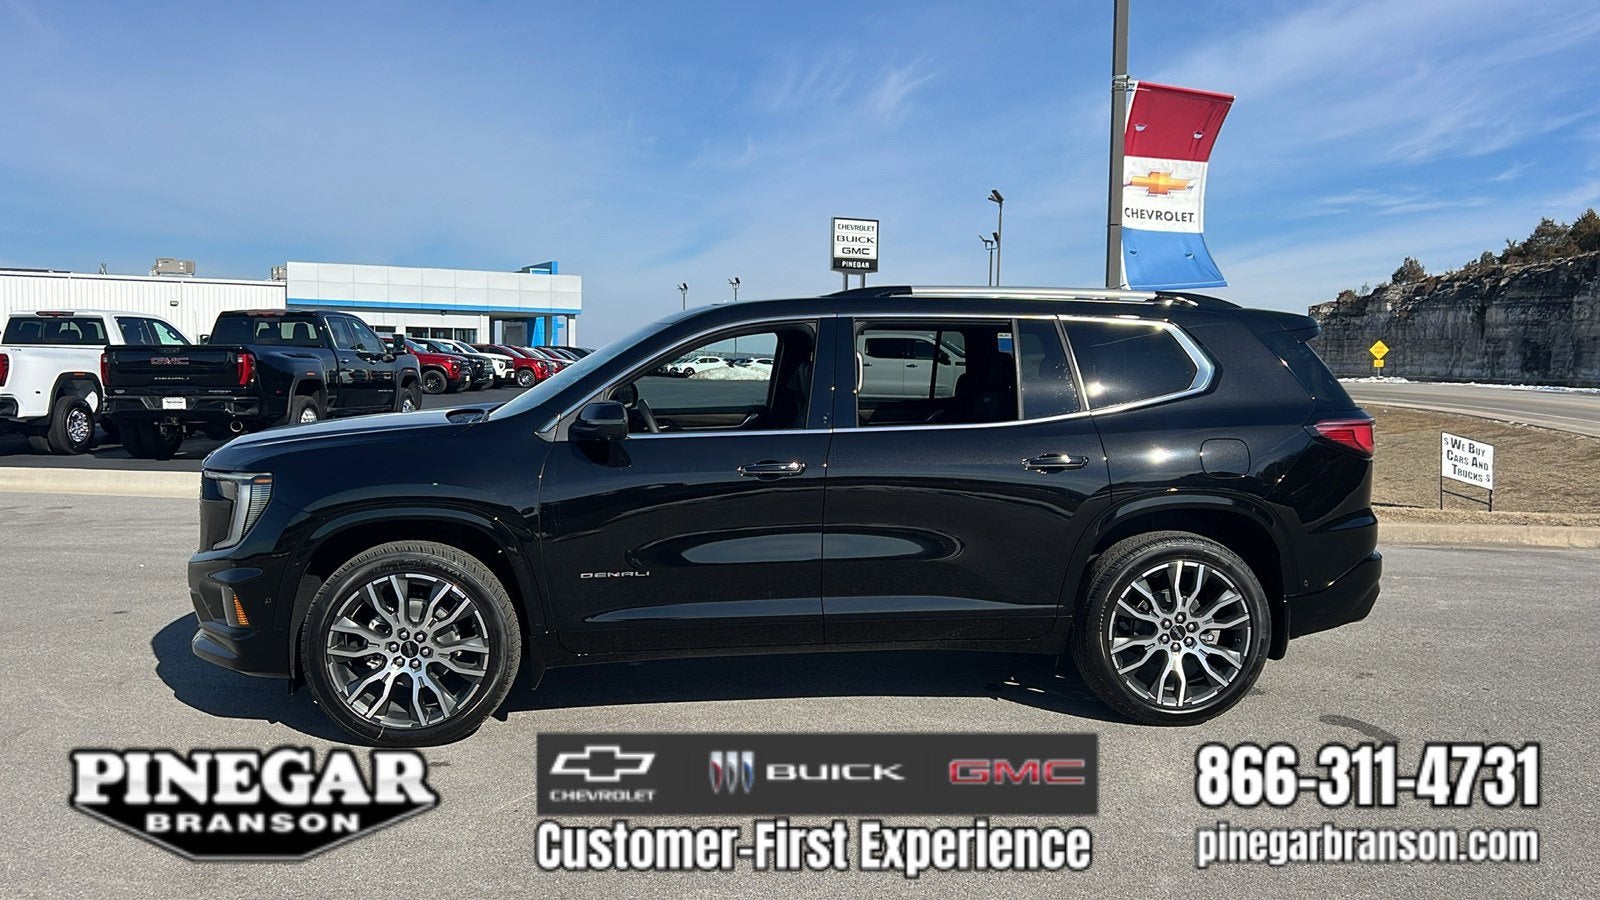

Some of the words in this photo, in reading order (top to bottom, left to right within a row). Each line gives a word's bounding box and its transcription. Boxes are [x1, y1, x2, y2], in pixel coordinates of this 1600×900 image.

[1124, 207, 1194, 222] CHEVROLET
[837, 223, 875, 231] CHEVROLET
[836, 235, 875, 244] BUICK
[841, 247, 870, 255] GMC
[841, 260, 870, 268] PINEGAR
[580, 570, 650, 579] DENALI
